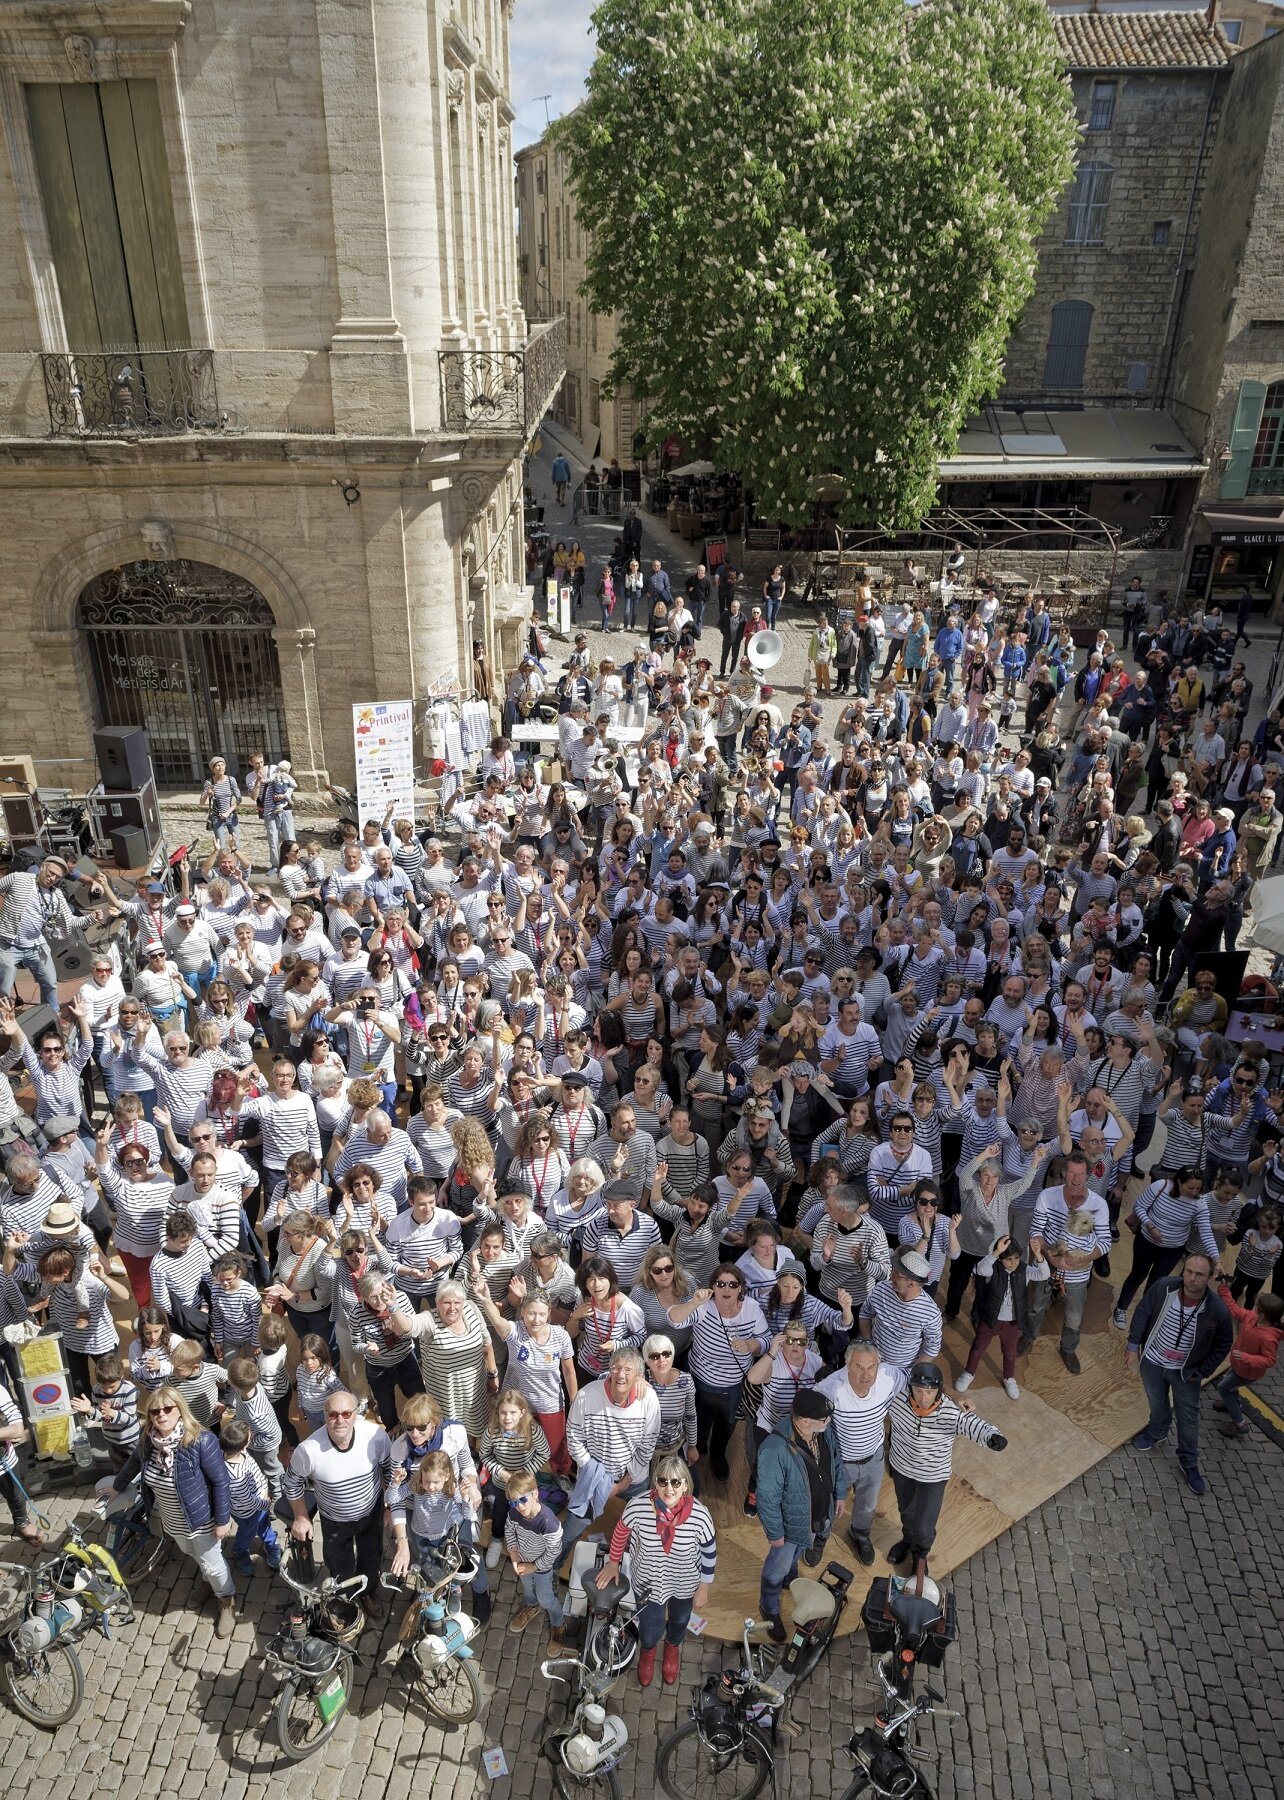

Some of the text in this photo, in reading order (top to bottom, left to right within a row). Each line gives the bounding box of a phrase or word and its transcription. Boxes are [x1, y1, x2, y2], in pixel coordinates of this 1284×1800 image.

[1244, 535, 1265, 543] GLACES
[136, 665, 159, 678] des
[112, 676, 158, 689] Métiers
[369, 708, 410, 728] Printival
